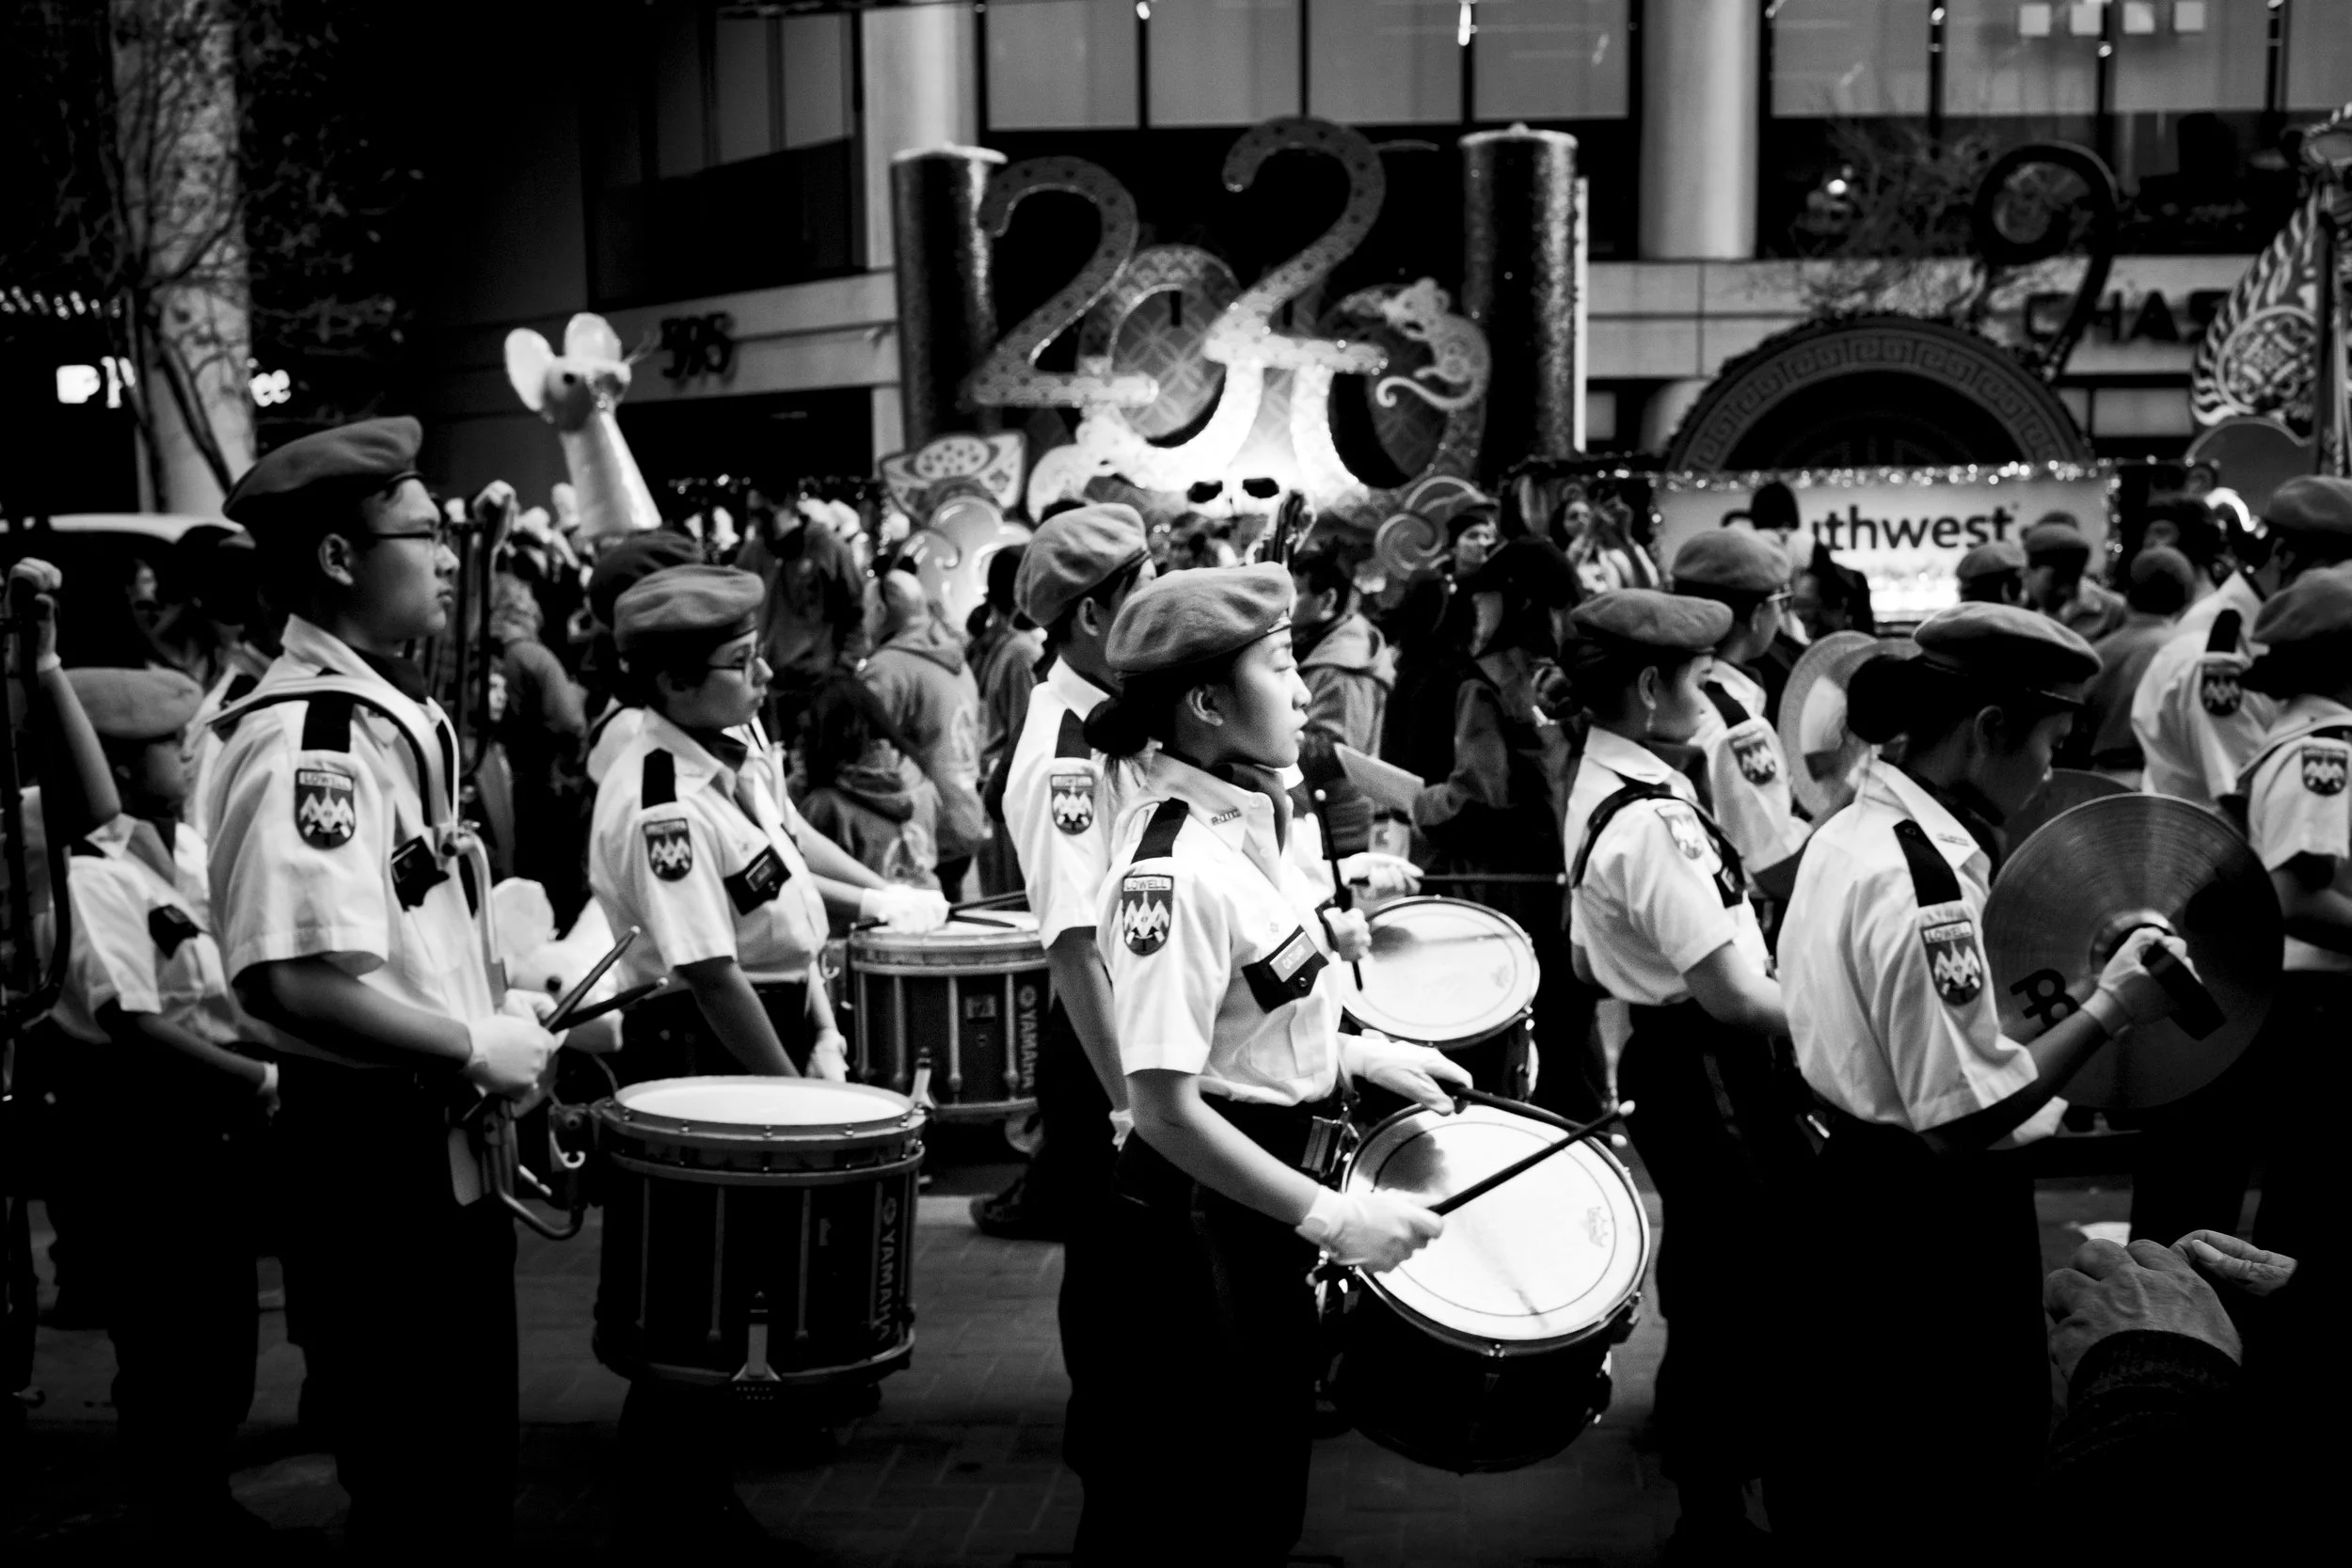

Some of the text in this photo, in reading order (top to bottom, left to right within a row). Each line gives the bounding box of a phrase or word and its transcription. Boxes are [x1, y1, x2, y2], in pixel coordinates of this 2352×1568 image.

[2025, 292, 2232, 342] CHAS
[1721, 504, 2013, 551] thwest
[1126, 879, 1168, 891] LOWELL
[1020, 1008, 1038, 1089] YAMAHA
[878, 1228, 896, 1341] YAMAHA
